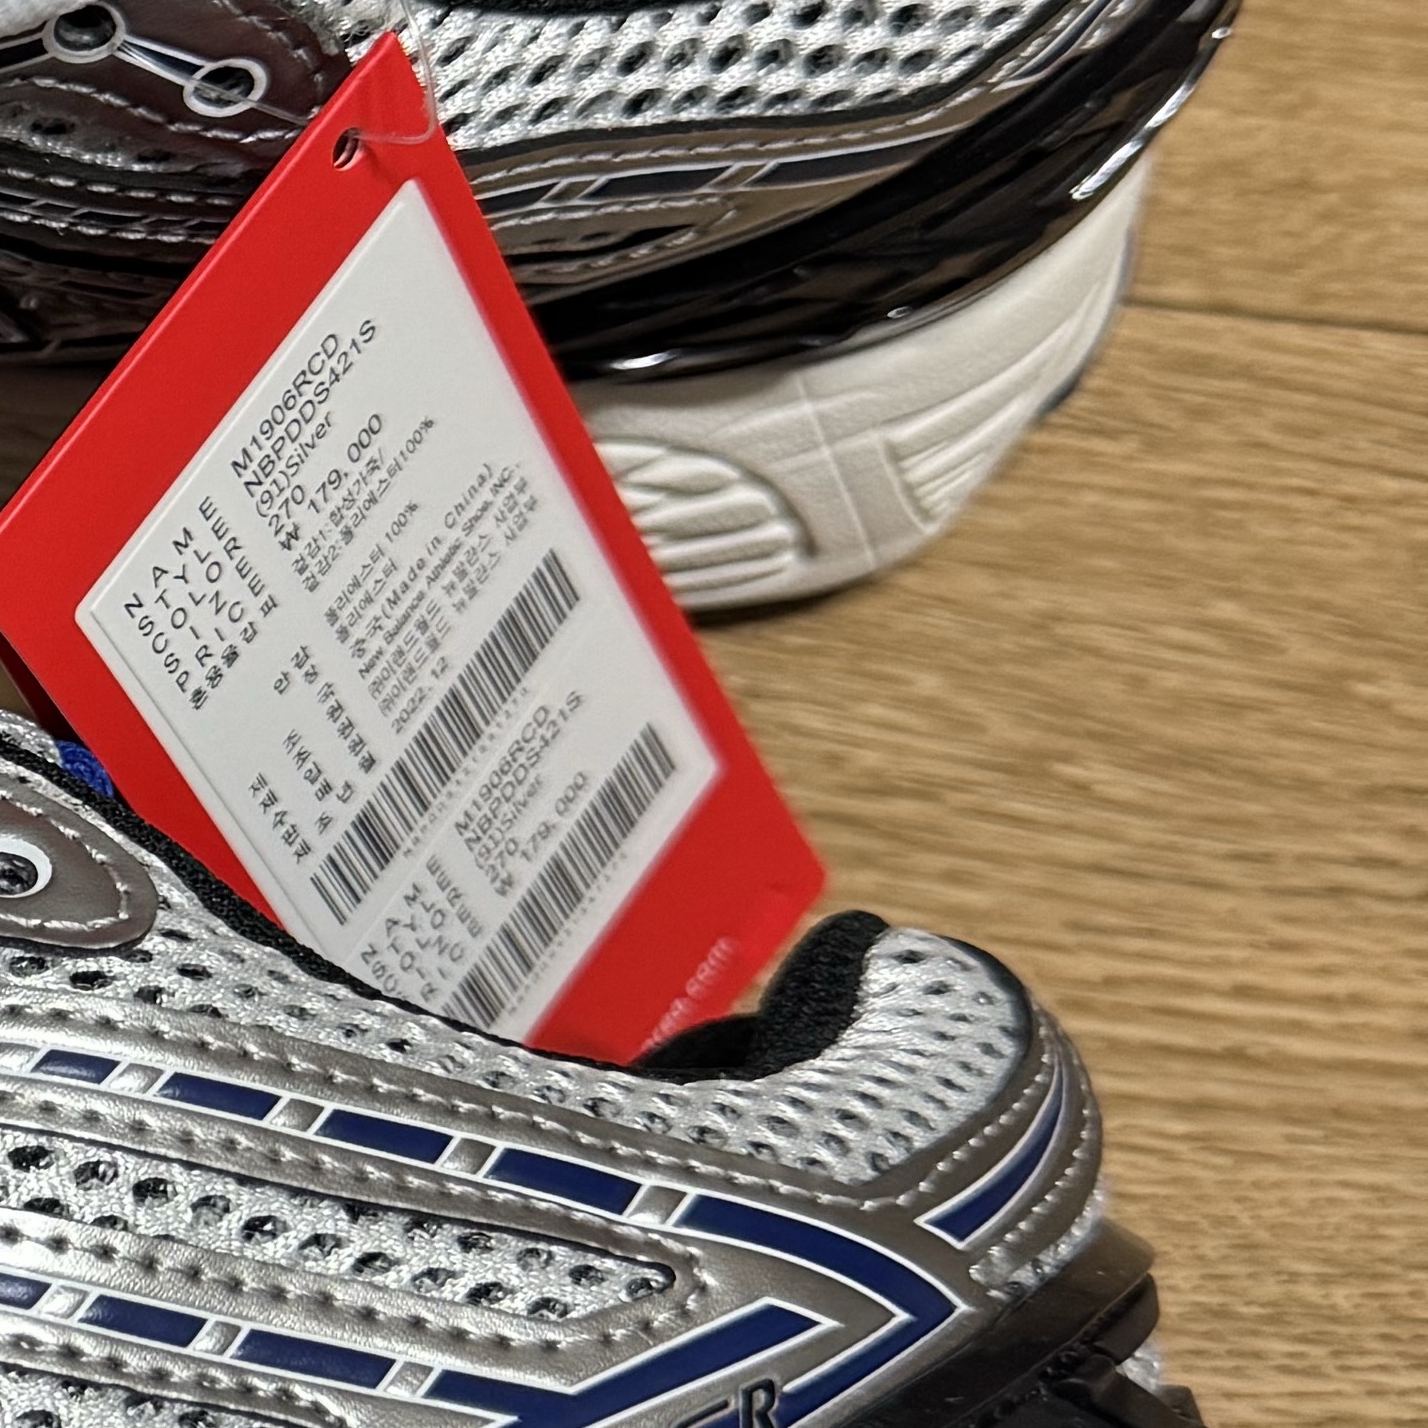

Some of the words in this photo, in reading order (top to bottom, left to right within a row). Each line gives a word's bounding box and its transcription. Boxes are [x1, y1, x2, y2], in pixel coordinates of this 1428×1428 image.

[124, 496, 217, 619] NAME
[231, 334, 339, 478] M1906RCD
[138, 516, 229, 637] STYLE
[243, 320, 376, 498] NBPDDS421S
[152, 536, 242, 654] COLOR
[256, 411, 331, 518] (91)Silver
[164, 556, 253, 674] SIZE
[268, 484, 305, 537] 270
[175, 573, 265, 693] PRICE
[454, 706, 550, 837] M1906RCD
[464, 691, 582, 853] NBPDDS421S
[485, 837, 519, 884] 270
